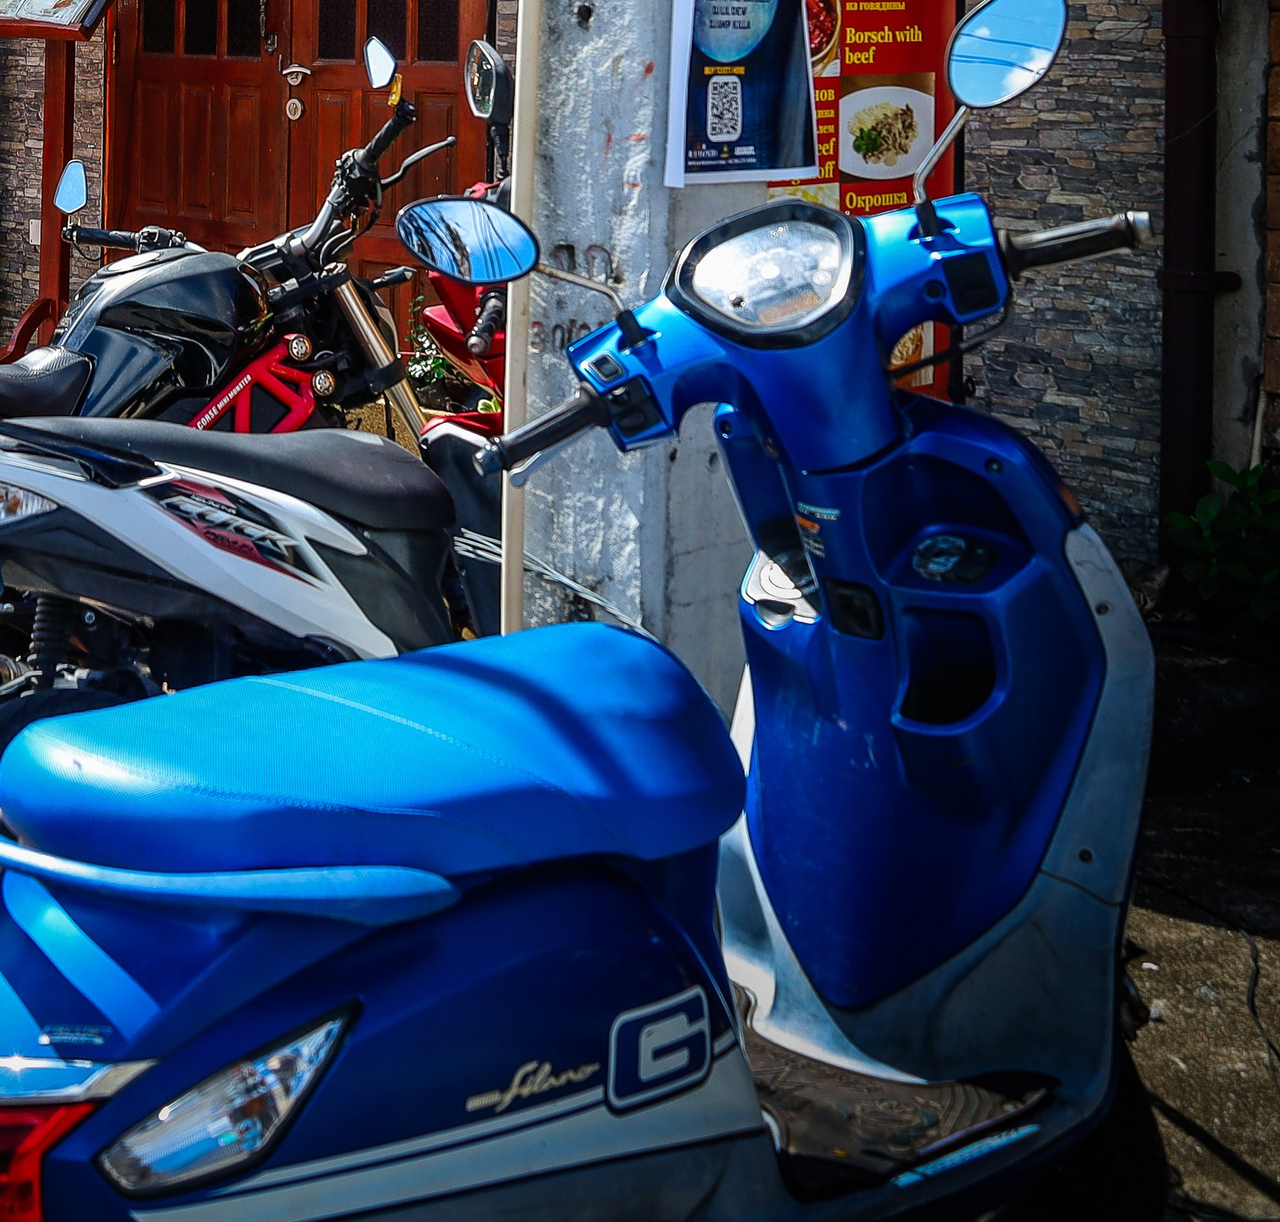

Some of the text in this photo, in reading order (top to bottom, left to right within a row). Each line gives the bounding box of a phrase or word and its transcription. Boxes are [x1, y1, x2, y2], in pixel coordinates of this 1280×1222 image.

[846, 25, 922, 44] Borsch with
[845, 46, 876, 65] beef
[845, 191, 908, 212] Окрошка
[196, 374, 252, 430] CORSE MINI MONSTER
